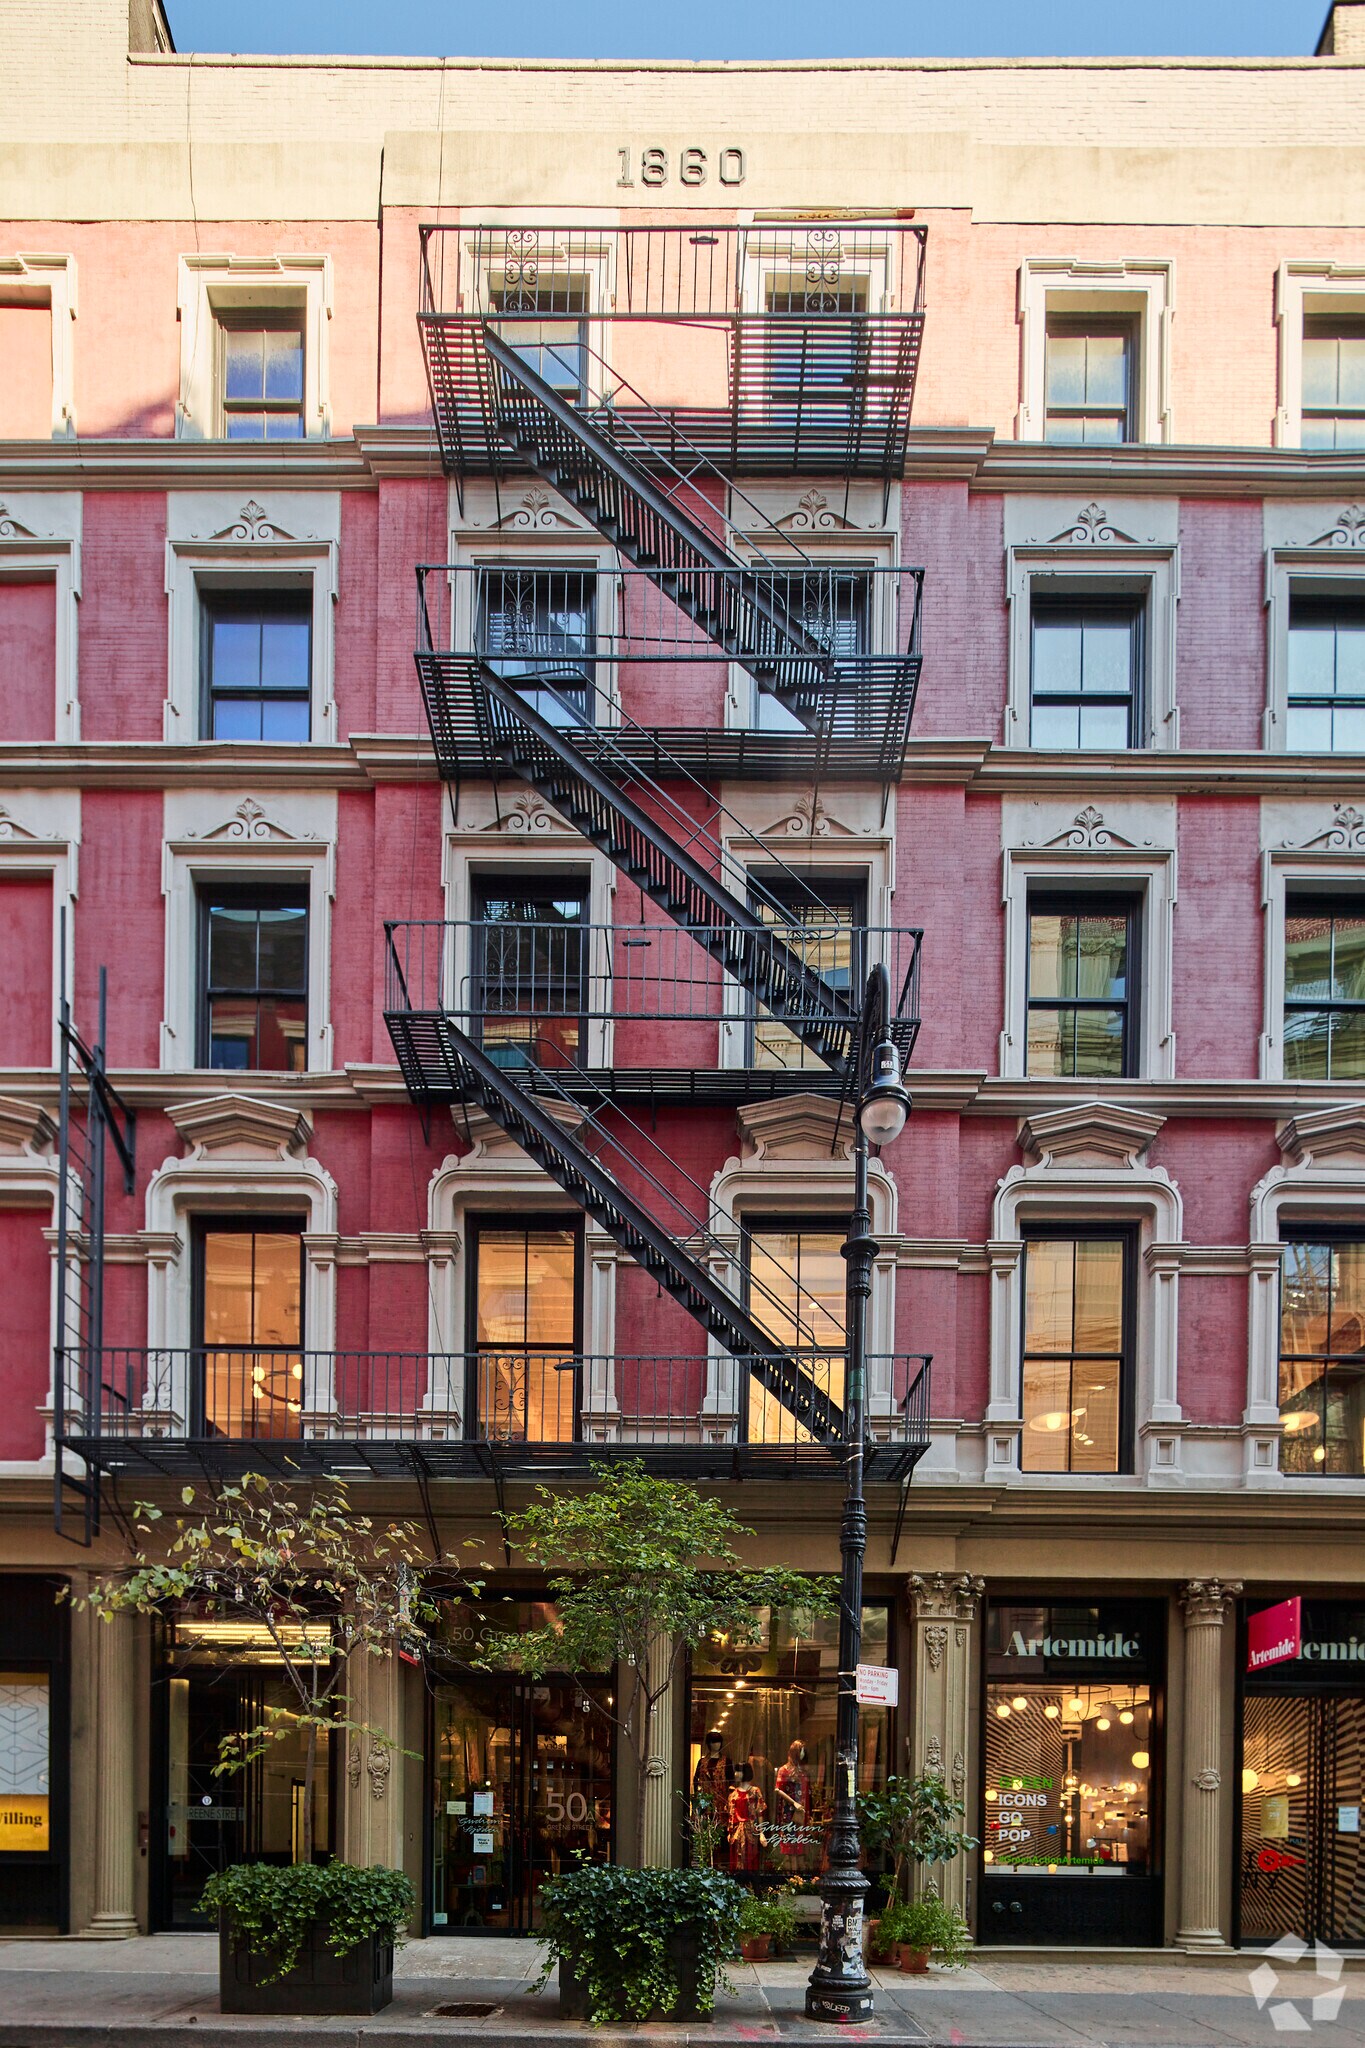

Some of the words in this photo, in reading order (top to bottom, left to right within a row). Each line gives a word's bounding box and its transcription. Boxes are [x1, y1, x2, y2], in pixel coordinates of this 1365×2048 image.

[616, 146, 747, 188] 1860
[453, 1627, 474, 1641] 50
[1003, 1630, 1139, 1658] Artemide
[1250, 1638, 1295, 1667] Artemide
[868, 1670, 889, 1679] PARKING
[999, 1776, 1053, 1789] GREEN
[999, 1794, 1048, 1807] ICONS
[0, 1812, 43, 1828] illing
[187, 1808, 215, 1819] REENE
[999, 1812, 1023, 1824] GO
[753, 1821, 825, 1836] Gudrun
[999, 1829, 1031, 1842] POP
[999, 1856, 1105, 1866] #GreenActionArtemide
